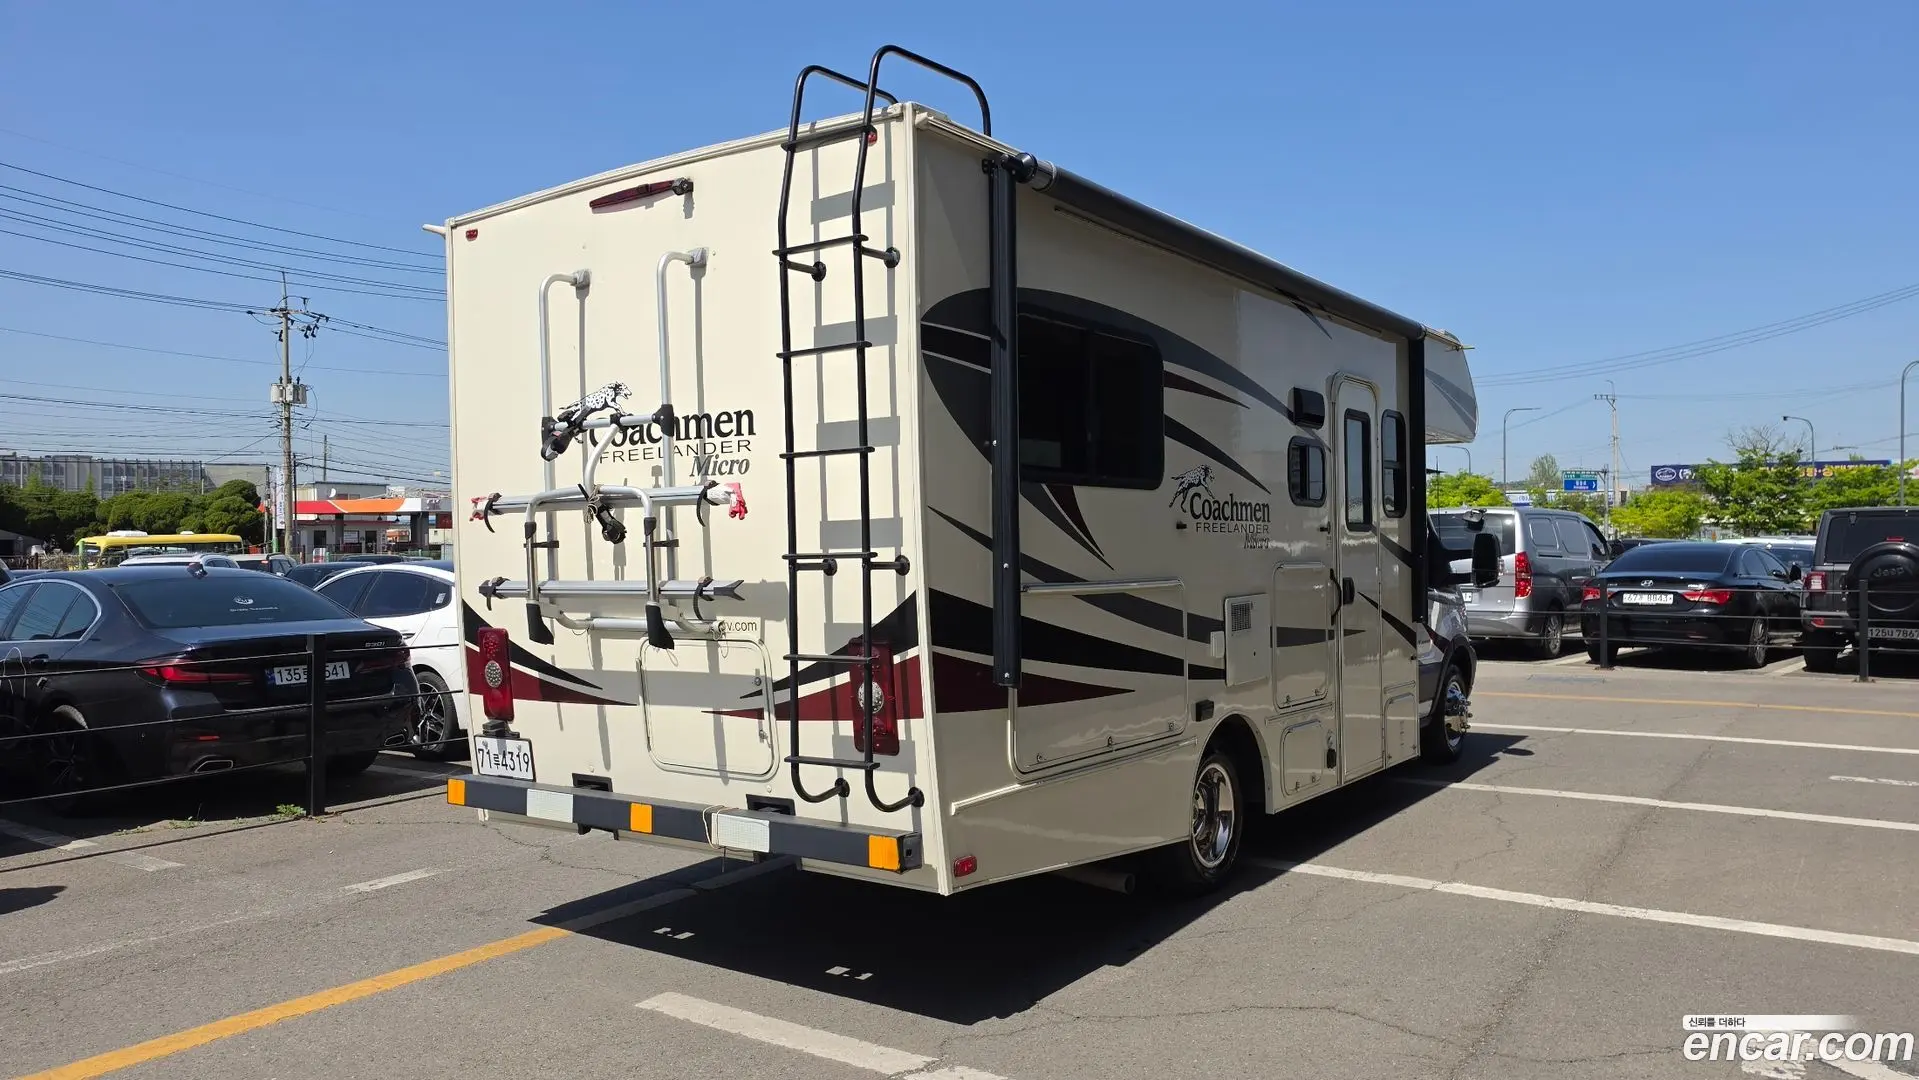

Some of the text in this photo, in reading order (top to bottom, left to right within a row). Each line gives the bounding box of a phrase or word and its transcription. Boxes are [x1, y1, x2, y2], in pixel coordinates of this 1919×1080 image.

[600, 440, 752, 463] FREELANDER
[689, 454, 750, 477] Micro
[1190, 492, 1271, 522] Coachmen
[1196, 522, 1269, 534] FREELANDER
[1873, 567, 1905, 578] Jeep
[725, 621, 757, 631] v.com
[478, 748, 530, 773] 71루4319
